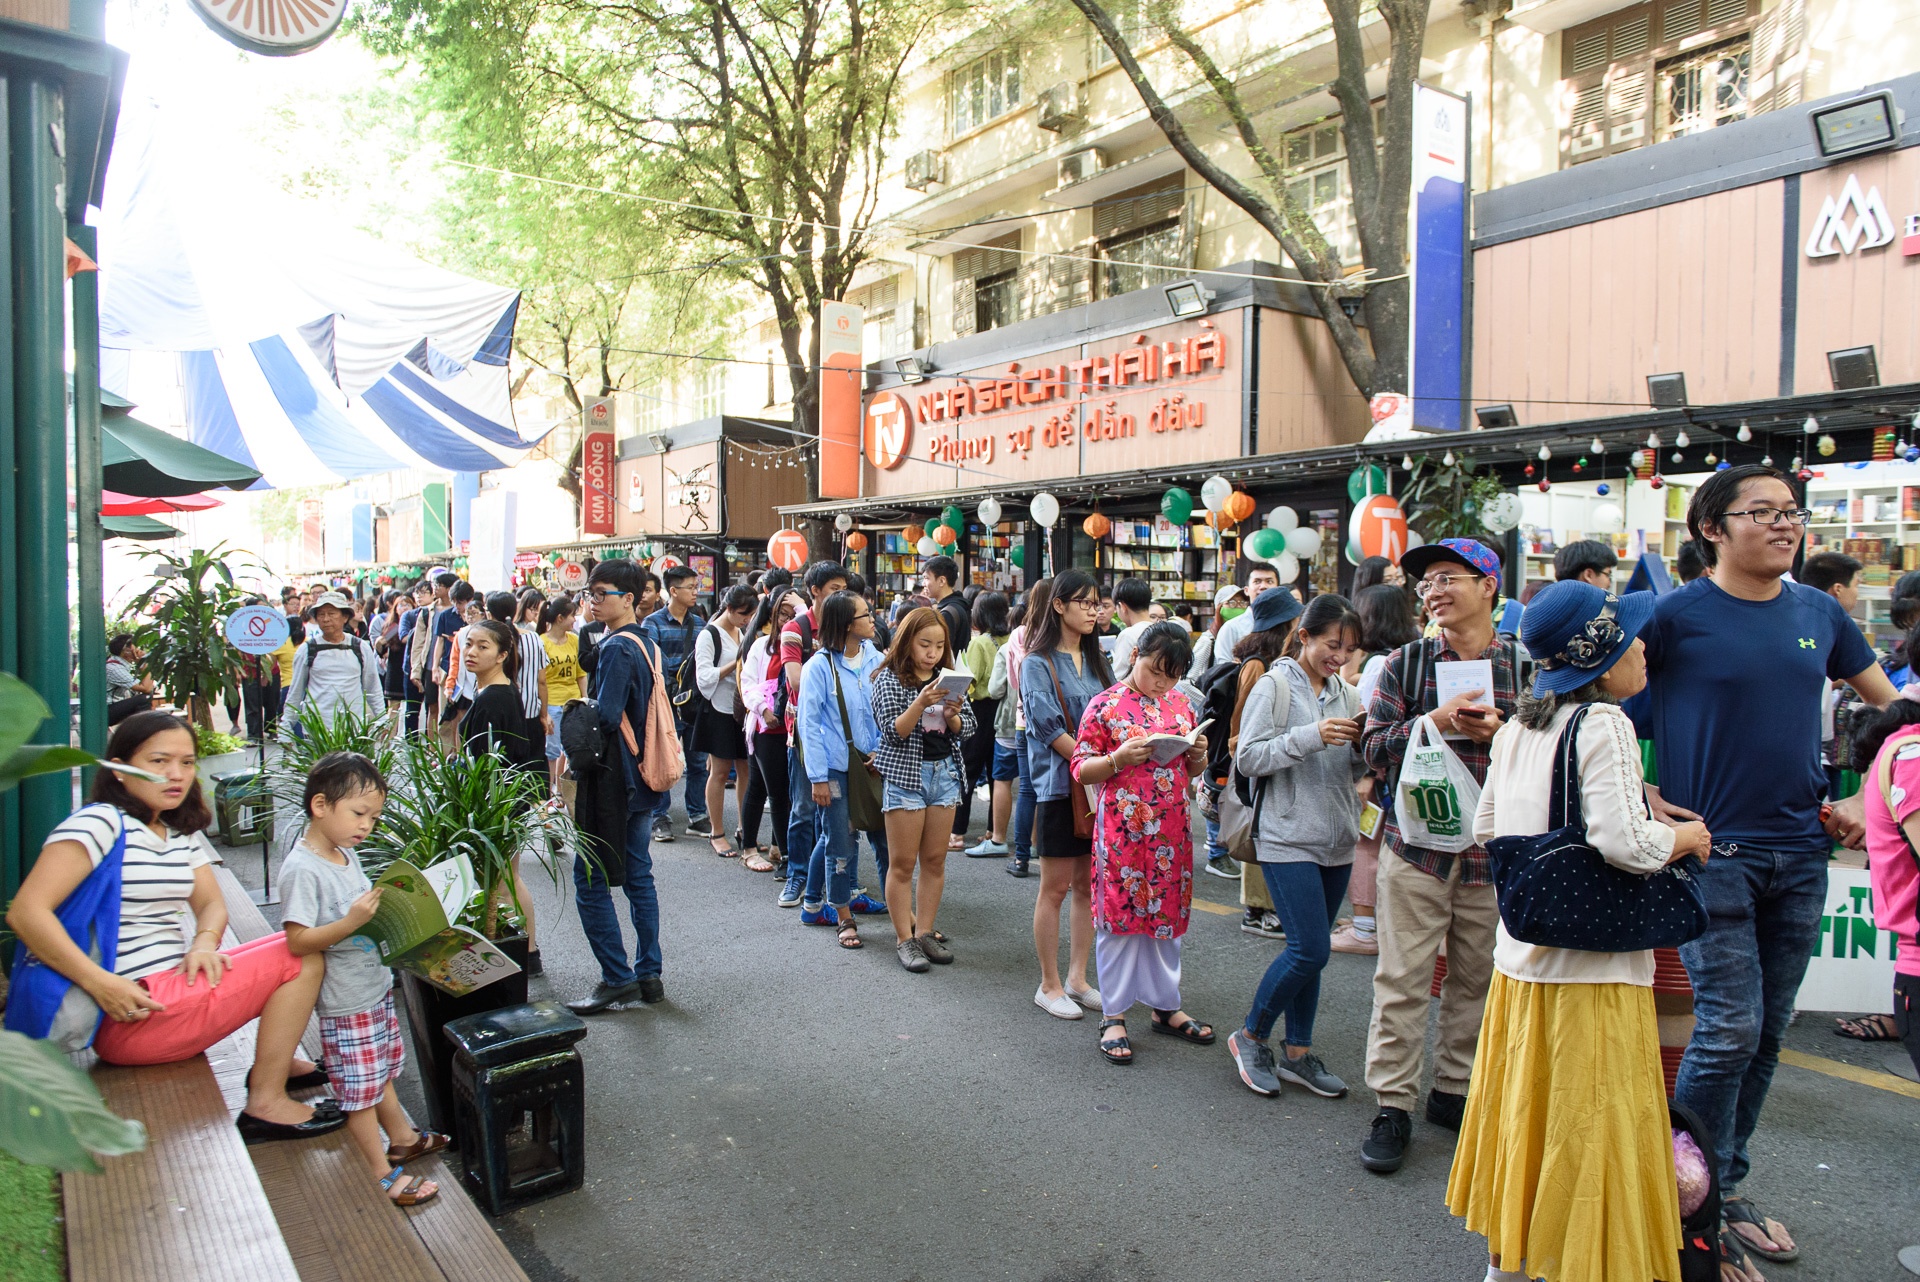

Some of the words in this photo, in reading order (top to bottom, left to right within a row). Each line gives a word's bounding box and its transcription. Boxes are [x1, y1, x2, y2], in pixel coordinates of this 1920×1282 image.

[917, 378, 973, 424] NHÀ
[975, 362, 1066, 413] SÁCH
[1069, 334, 1159, 394] THÁI
[1162, 319, 1227, 379] HÀ
[928, 434, 995, 469] Phụng
[1005, 424, 1034, 460] sự
[1041, 405, 1075, 448] để
[1083, 400, 1136, 443] dẫn
[587, 441, 605, 489] ĐỒNG
[591, 495, 605, 524] KIM
[558, 666, 573, 678] 46
